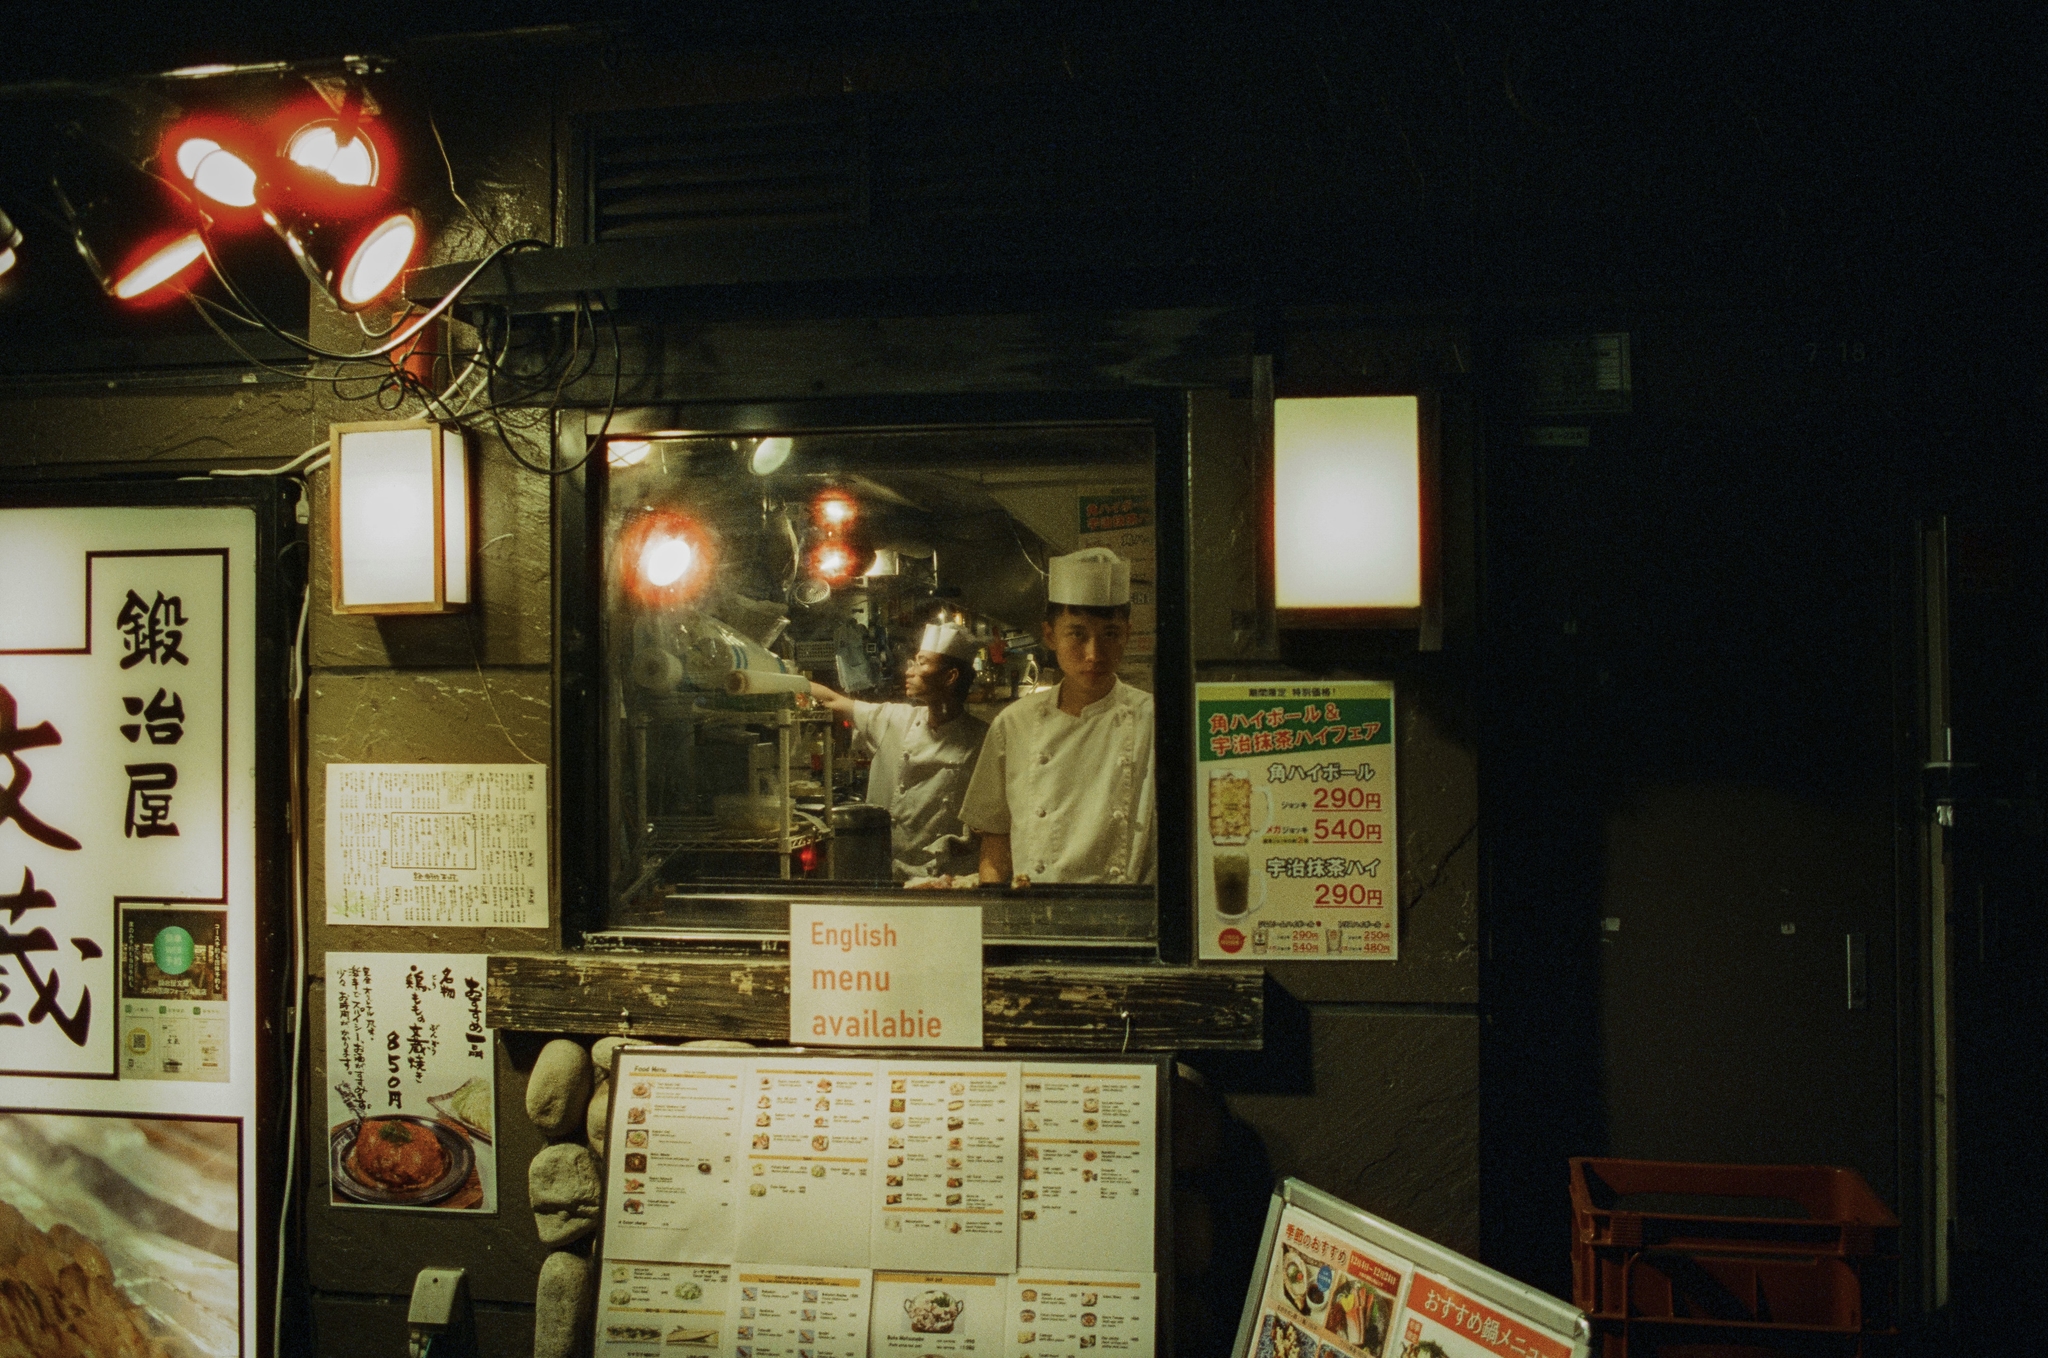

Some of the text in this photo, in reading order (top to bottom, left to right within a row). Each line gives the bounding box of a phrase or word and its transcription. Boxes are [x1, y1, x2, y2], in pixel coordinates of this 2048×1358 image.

[117, 589, 190, 838] 鍛冶屋
[1209, 703, 1322, 733] 角ハイボール
[1210, 722, 1381, 757] 宇治抹茶ハイフェア
[1268, 762, 1375, 783] 角ハイボール
[1313, 787, 1382, 809] 290円
[1314, 818, 1382, 840] 540円
[1266, 857, 1381, 878] 宇治抹茶ハイ
[1315, 884, 1383, 906] 290円
[811, 921, 897, 952] English
[440, 967, 456, 999] 名物
[812, 969, 890, 991] menu
[1285, 1222, 1348, 1266] 季節のおすすめ
[1424, 1289, 1549, 1358] おすすめ鍋メニュ
